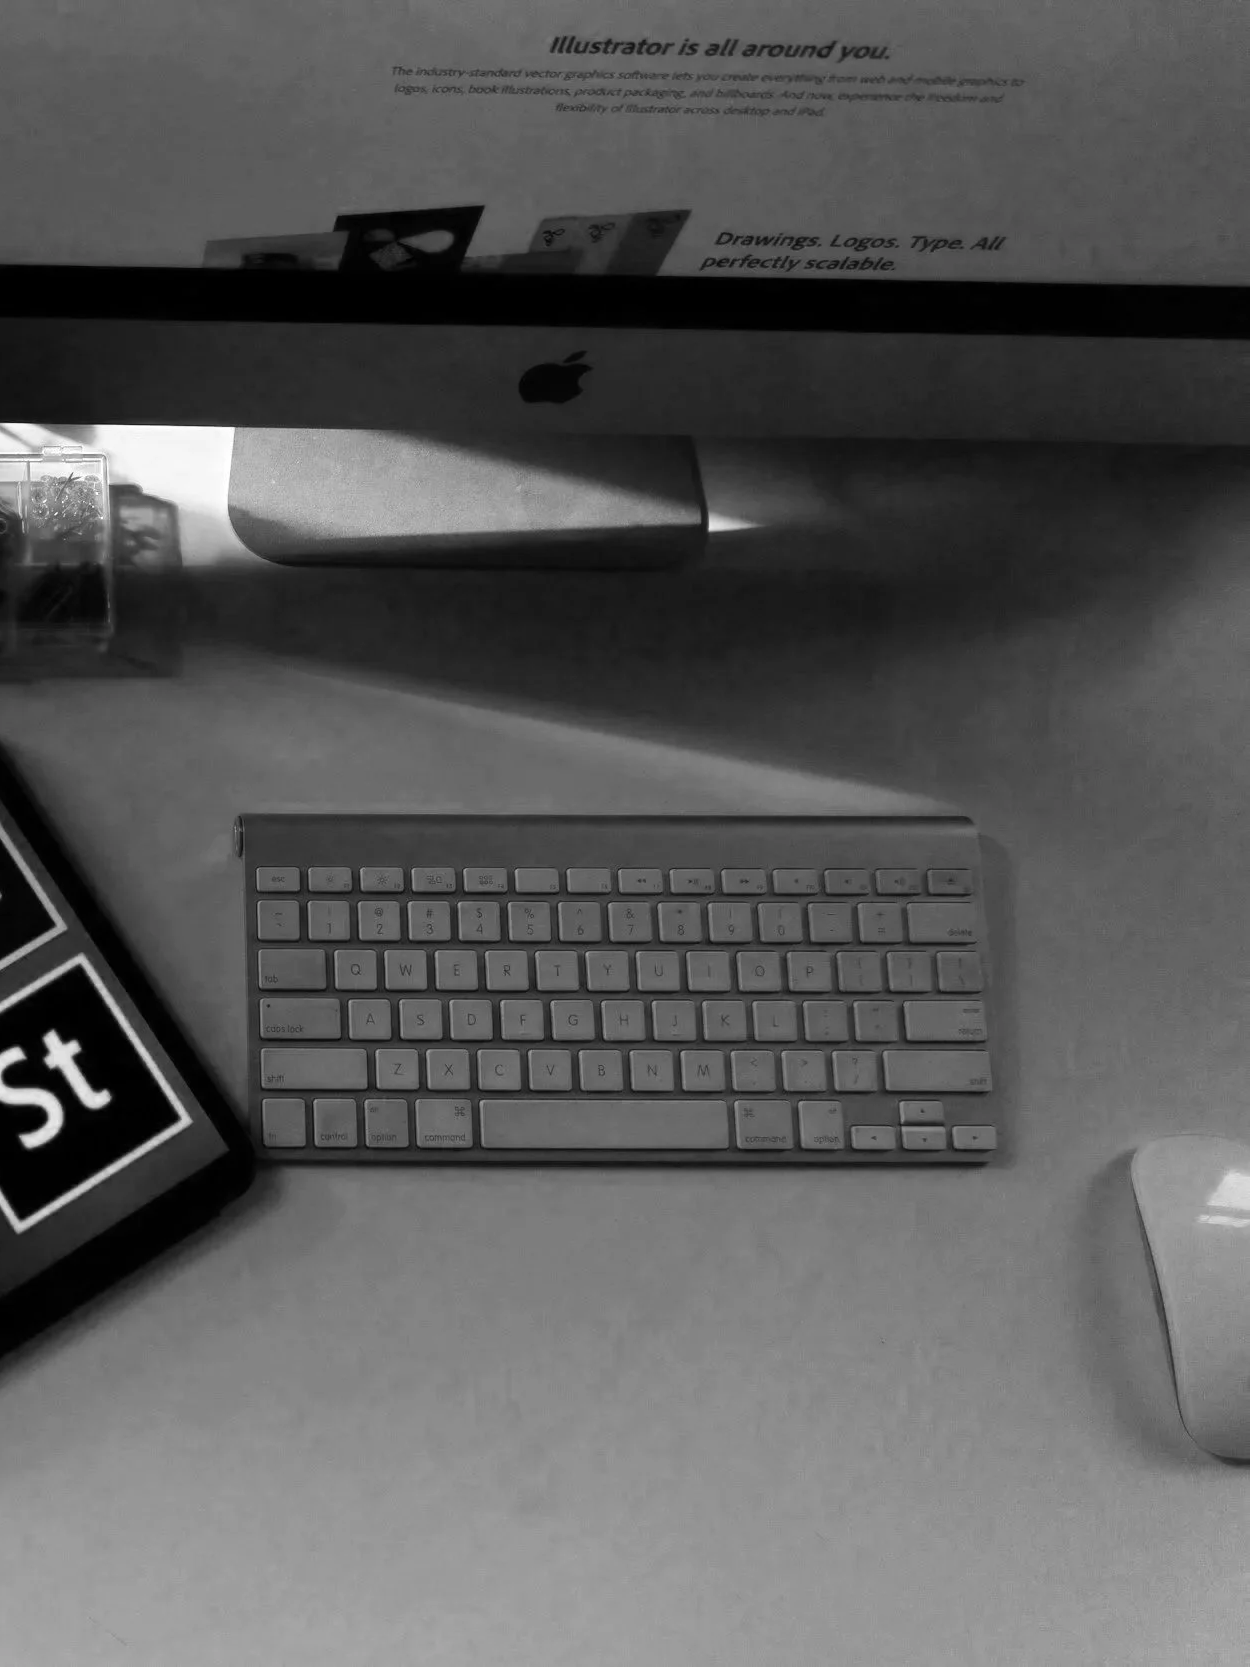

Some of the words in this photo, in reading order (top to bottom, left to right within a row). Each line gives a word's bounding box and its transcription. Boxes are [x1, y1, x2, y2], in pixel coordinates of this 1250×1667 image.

[549, 36, 674, 56] Illustrator
[678, 38, 699, 56] is
[704, 38, 738, 57] all
[741, 40, 838, 58] around
[837, 43, 891, 63] you.
[392, 66, 413, 76] The
[415, 67, 522, 79] industry-standard
[525, 69, 563, 79] vector
[564, 69, 614, 81] graphics
[617, 70, 669, 80] software
[672, 71, 693, 81] lets
[696, 73, 719, 83] you
[722, 73, 759, 82] create
[761, 73, 827, 85] everything
[828, 74, 859, 84] from
[860, 75, 885, 84] web
[887, 75, 913, 85] and
[914, 76, 956, 85] mobile
[957, 77, 1008, 87] graphics
[1011, 78, 1025, 87] to
[394, 84, 429, 95] logos,
[431, 84, 465, 95] icons,
[468, 85, 499, 95] book
[501, 85, 571, 97] illustrations,
[573, 87, 621, 98] product
[623, 87, 686, 100] packaging,
[689, 88, 713, 98] and
[781, 90, 804, 100] And
[837, 92, 904, 103] experience
[906, 92, 925, 102] the
[979, 93, 1004, 103] and
[555, 102, 607, 115] flexibility
[610, 103, 625, 113] of
[626, 104, 682, 115] Illustrator
[683, 106, 719, 115] across
[723, 106, 770, 117] desktop
[772, 107, 796, 116] and
[714, 231, 822, 250] Drawings.
[829, 233, 900, 251] Logos.
[910, 235, 965, 253] Type.
[970, 236, 1006, 251] All
[699, 255, 802, 271] perfectly
[804, 257, 896, 272] scalable.
[376, 924, 384, 935] 2
[426, 924, 434, 935] 3
[476, 924, 483, 935] 4
[526, 924, 534, 935] 5
[577, 924, 584, 935] 6
[627, 925, 634, 936] 7
[677, 925, 685, 936] 8
[728, 925, 735, 936] 9
[778, 925, 785, 936] 0
[351, 964, 360, 976] Q
[400, 964, 412, 976] W
[453, 964, 460, 976] E
[503, 964, 511, 976] R
[553, 964, 561, 976] T
[603, 964, 612, 976] Y
[654, 964, 664, 976] U
[755, 964, 765, 976] O
[806, 964, 814, 976] P
[264, 975, 278, 984] tab
[366, 1014, 375, 1026] A
[417, 1014, 424, 1026] S
[467, 1014, 476, 1026] D
[520, 1014, 526, 1026] F
[568, 1014, 578, 1026] G
[620, 1014, 629, 1026] H
[672, 1014, 677, 1026] J
[721, 1014, 730, 1026] K
[773, 1014, 778, 1026] L
[287, 1024, 304, 1033] lock
[394, 1064, 402, 1076] Z
[444, 1064, 454, 1076] X
[494, 1064, 503, 1076] C
[546, 1064, 555, 1076] V
[598, 1064, 606, 1076] B
[647, 1064, 658, 1076] N
[698, 1064, 710, 1076] M
[266, 1074, 284, 1083] shift
[371, 1132, 397, 1142] option
[424, 1132, 465, 1142] command
